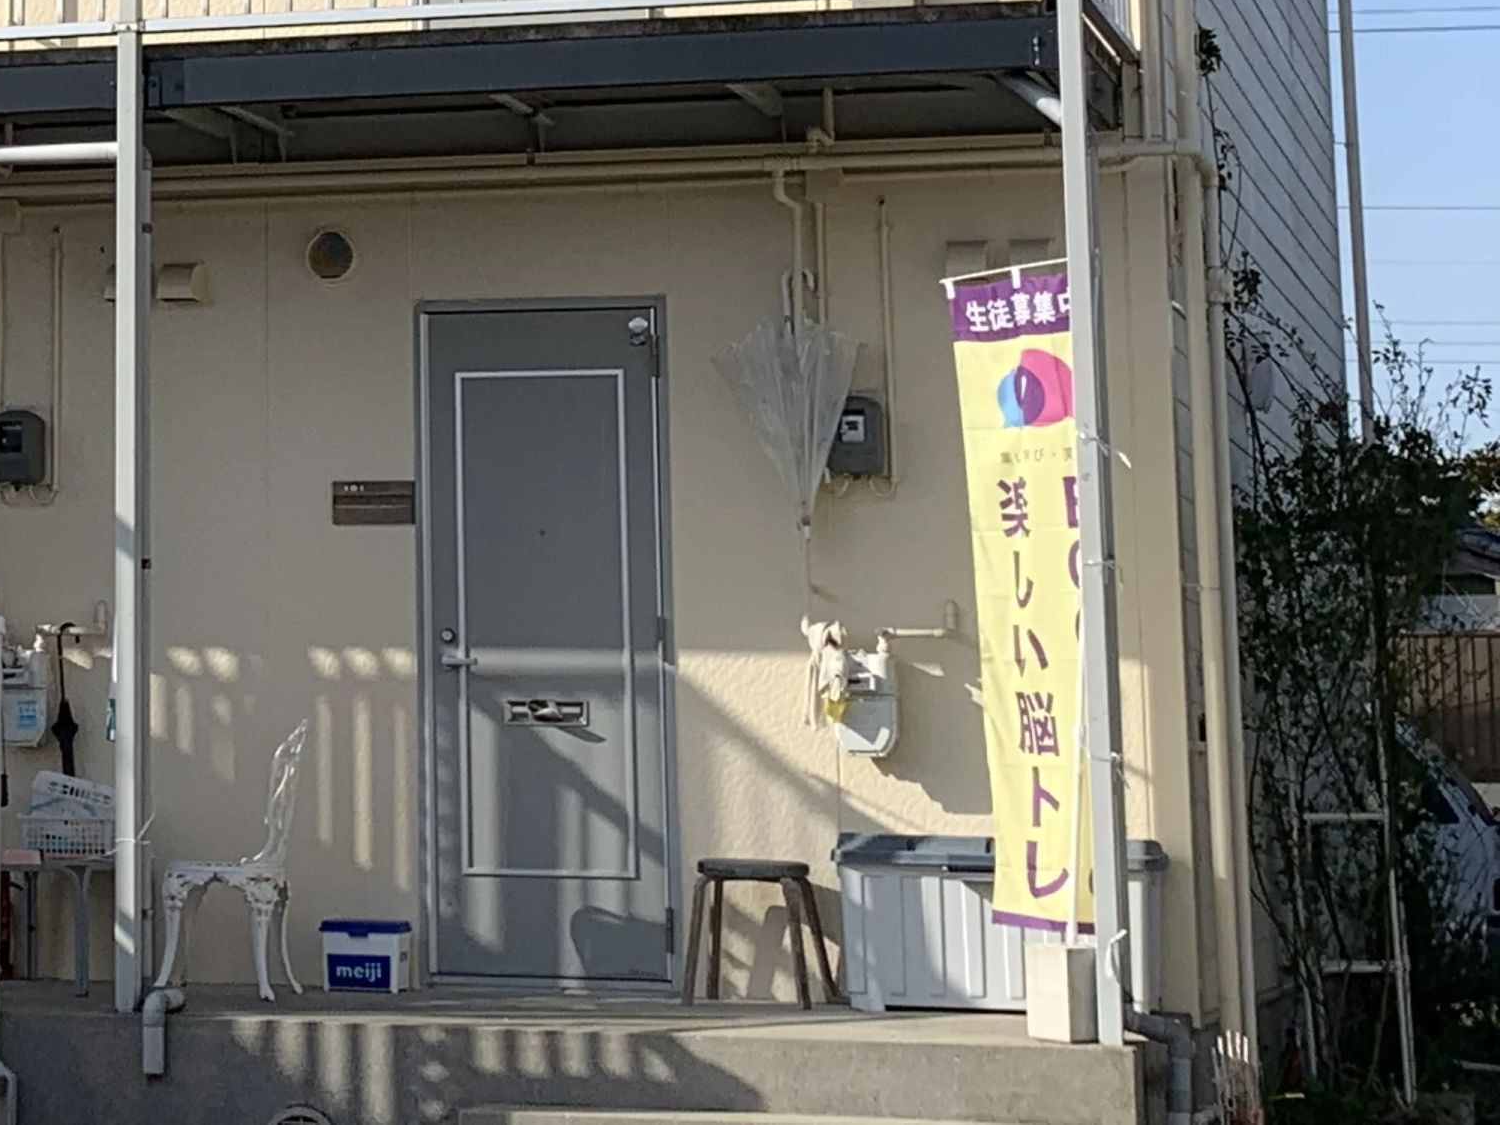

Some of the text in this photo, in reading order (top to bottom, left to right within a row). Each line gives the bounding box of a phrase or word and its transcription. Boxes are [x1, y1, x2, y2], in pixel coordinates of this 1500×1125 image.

[997, 476, 1070, 900] 楽しい脳トレ
[336, 963, 382, 983] meiji
